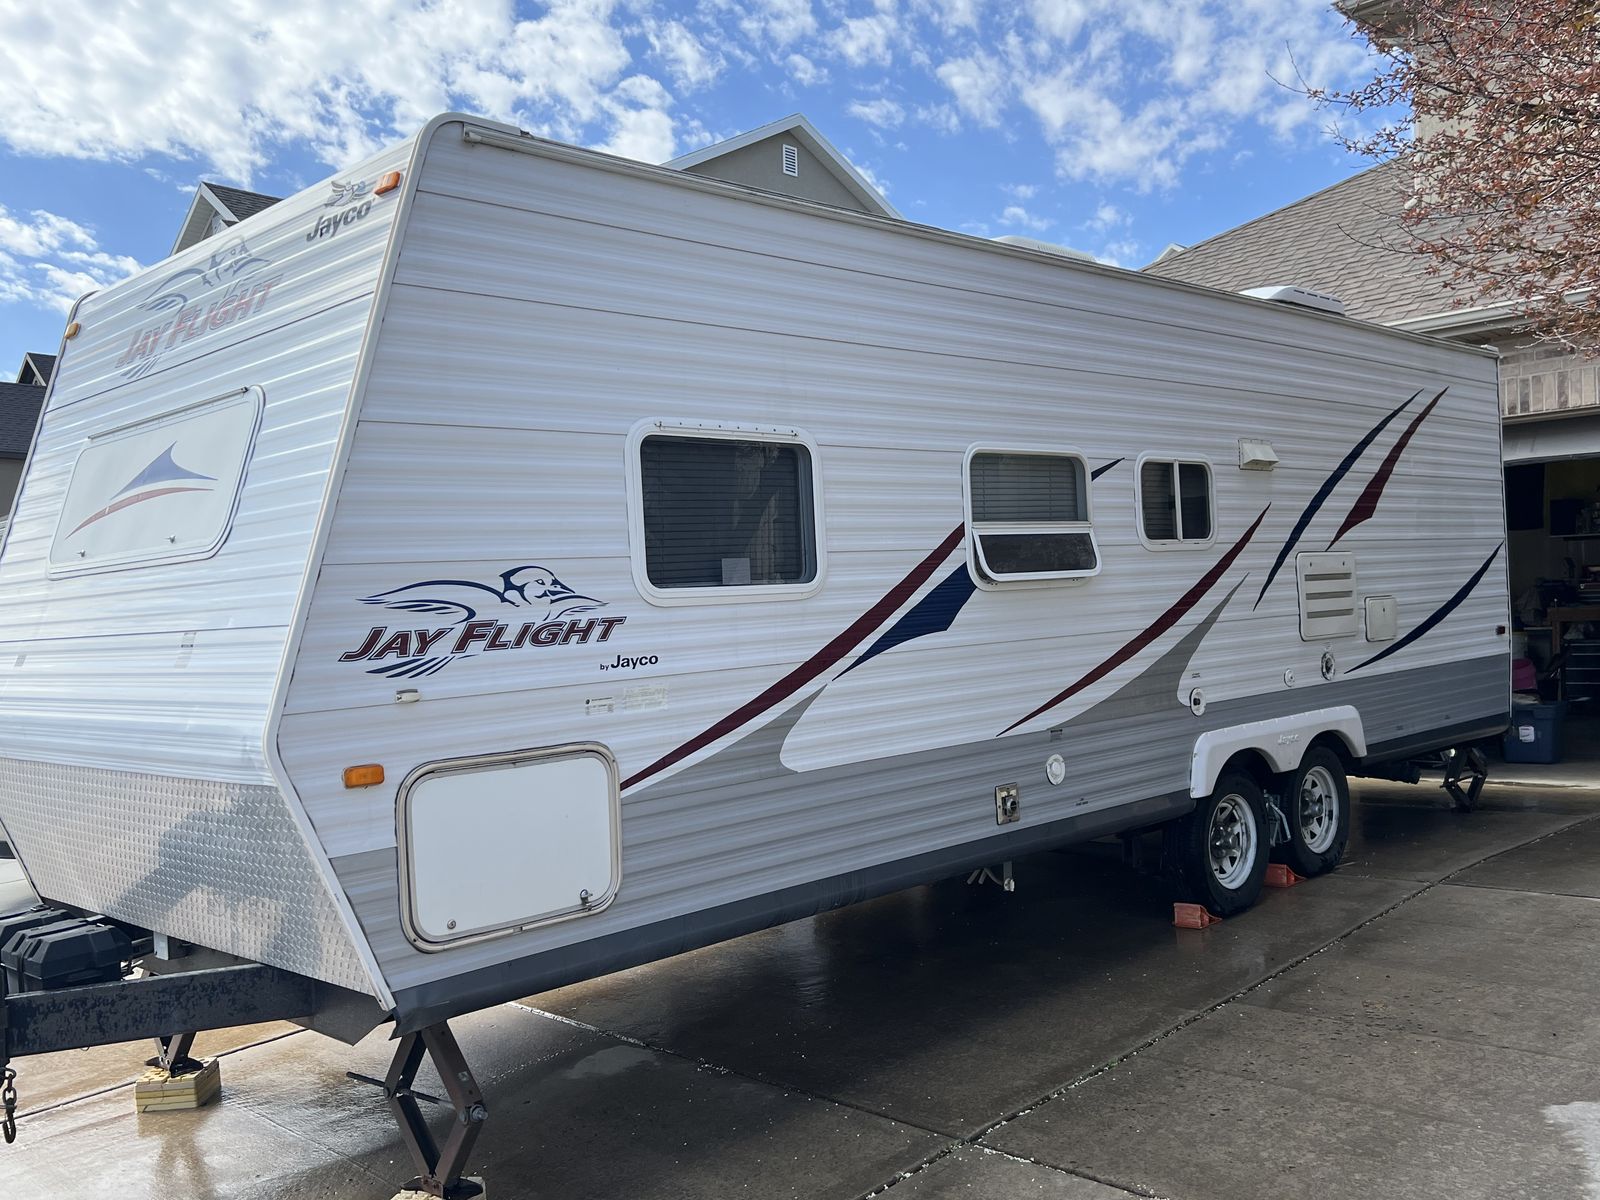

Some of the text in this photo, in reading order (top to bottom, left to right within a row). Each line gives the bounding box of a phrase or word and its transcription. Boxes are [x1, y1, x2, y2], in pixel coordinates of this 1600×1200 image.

[306, 199, 373, 242] Jayco
[115, 274, 284, 369] JAY FLIGHT
[338, 616, 627, 662] JAY FLIGHT
[610, 654, 659, 669] Jayco
